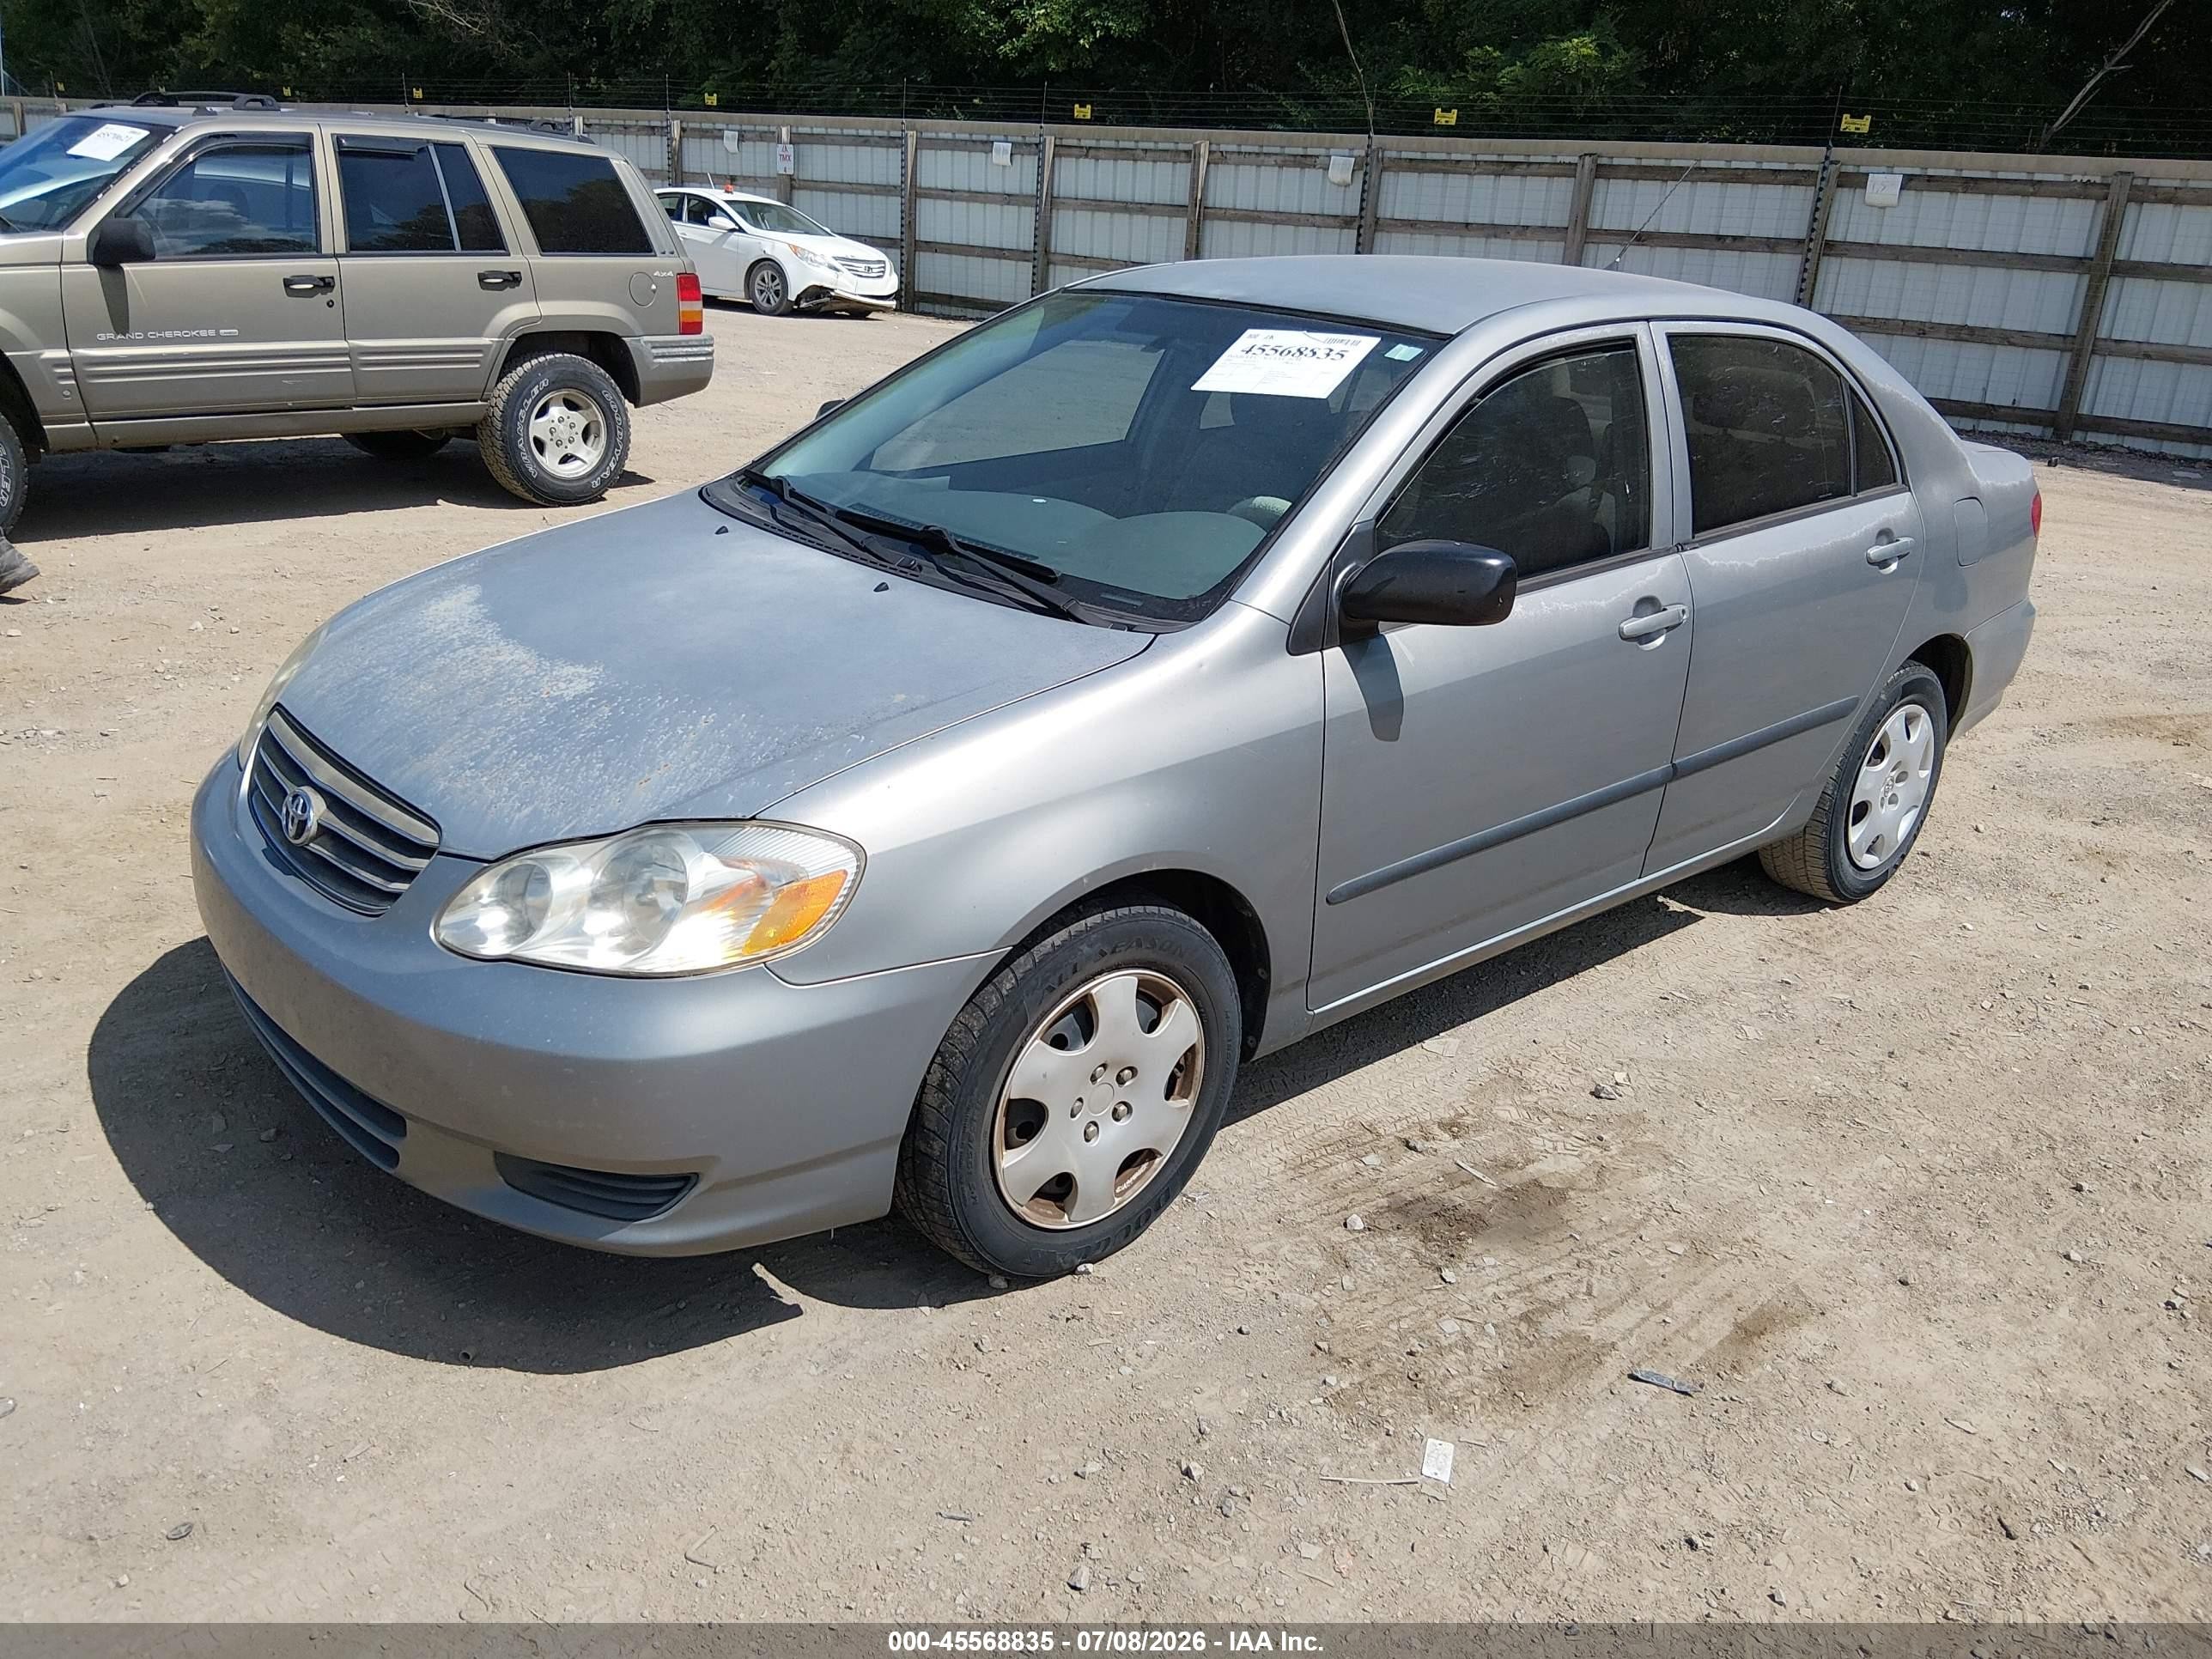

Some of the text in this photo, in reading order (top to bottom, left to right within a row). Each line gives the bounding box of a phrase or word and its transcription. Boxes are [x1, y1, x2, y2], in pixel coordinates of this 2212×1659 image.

[96, 332, 144, 341] GRAND
[148, 330, 216, 339] CHEROKEE
[516, 378, 550, 478] WRANGLER
[591, 389, 623, 489] GOODYEAR
